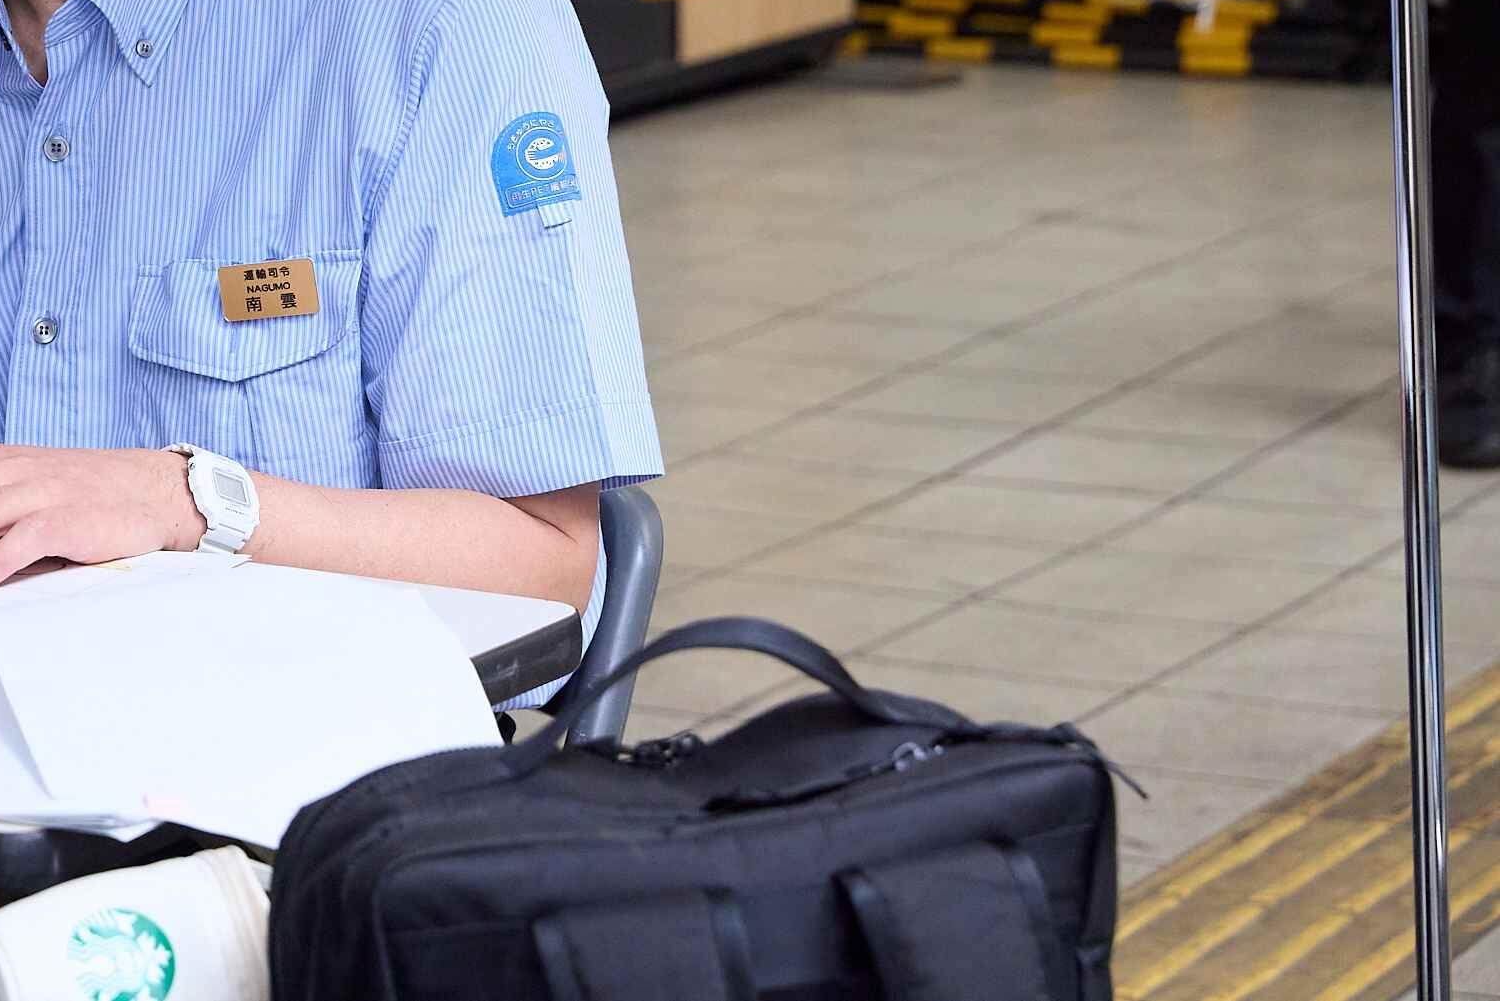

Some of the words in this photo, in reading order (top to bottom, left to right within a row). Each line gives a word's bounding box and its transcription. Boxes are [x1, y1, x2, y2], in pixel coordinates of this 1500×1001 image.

[244, 266, 290, 281] 運輸司令
[246, 282, 291, 293] NAGUMO
